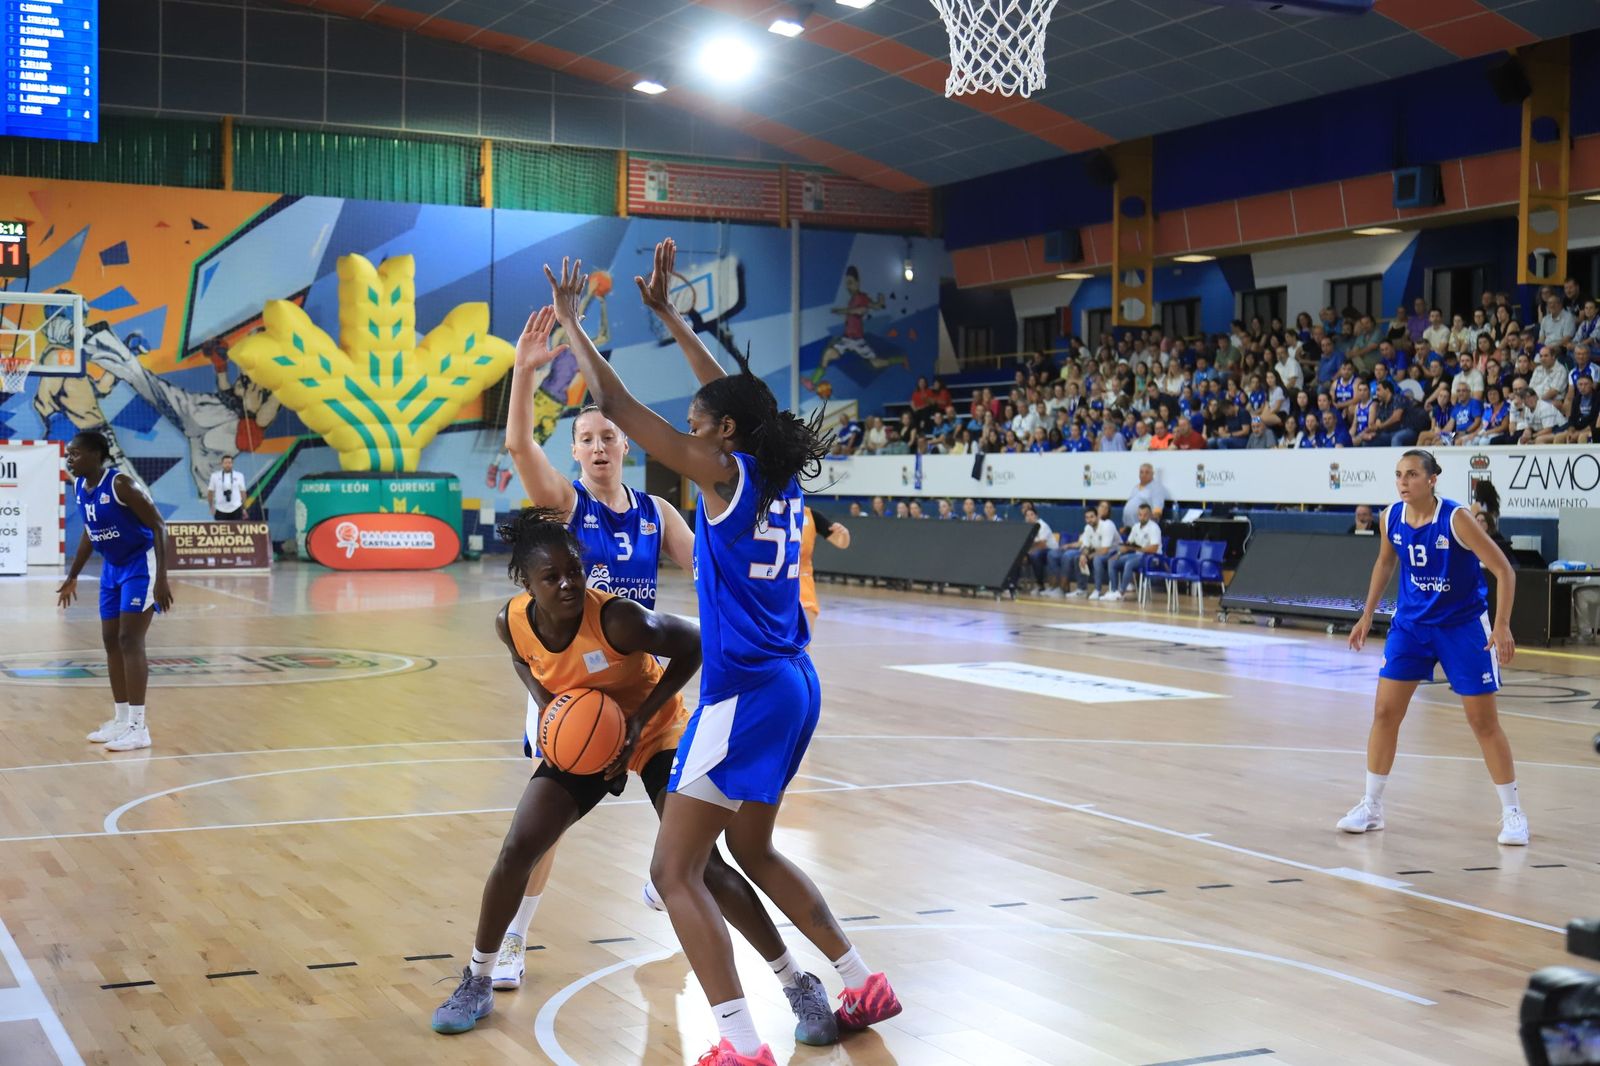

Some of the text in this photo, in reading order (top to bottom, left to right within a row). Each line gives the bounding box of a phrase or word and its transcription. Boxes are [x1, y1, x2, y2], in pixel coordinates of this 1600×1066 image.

[1341, 470, 1376, 482] ZAMORA
[302, 483, 331, 493] ZAMORA
[341, 481, 369, 493] LEÓN
[389, 482, 436, 493] OURENSE
[1507, 498, 1588, 508] AYUNTAMIENTO
[85, 503, 97, 522] 14
[167, 524, 269, 536] IERRA DEL VINO
[175, 536, 254, 547] DE ZAMORA
[614, 531, 634, 561] 3
[1407, 544, 1428, 567] 13
